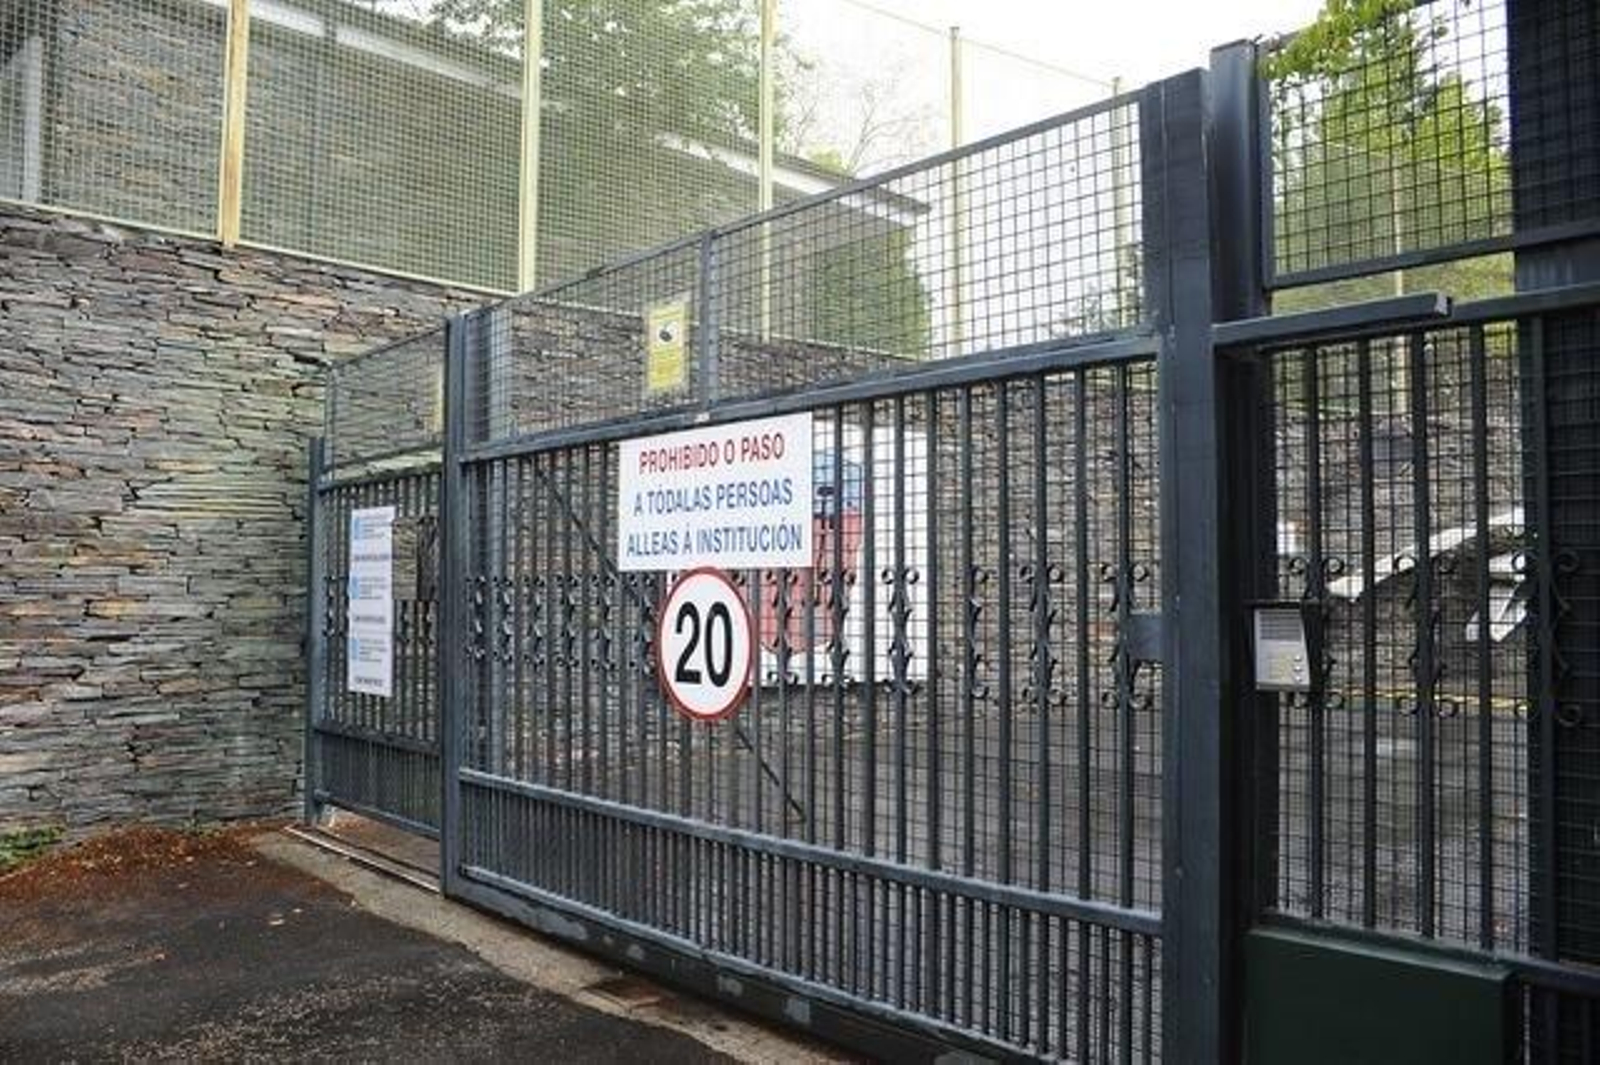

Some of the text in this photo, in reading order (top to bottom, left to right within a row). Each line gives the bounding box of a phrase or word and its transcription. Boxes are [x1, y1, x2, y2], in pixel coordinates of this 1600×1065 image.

[640, 432, 784, 474] PROHIBIDO O PASO
[634, 491, 643, 516] A
[716, 478, 792, 510] PERSOAS
[627, 530, 678, 557] ALLEAS
[697, 518, 802, 553] INSTITUCIÓN
[675, 601, 732, 687] 20
